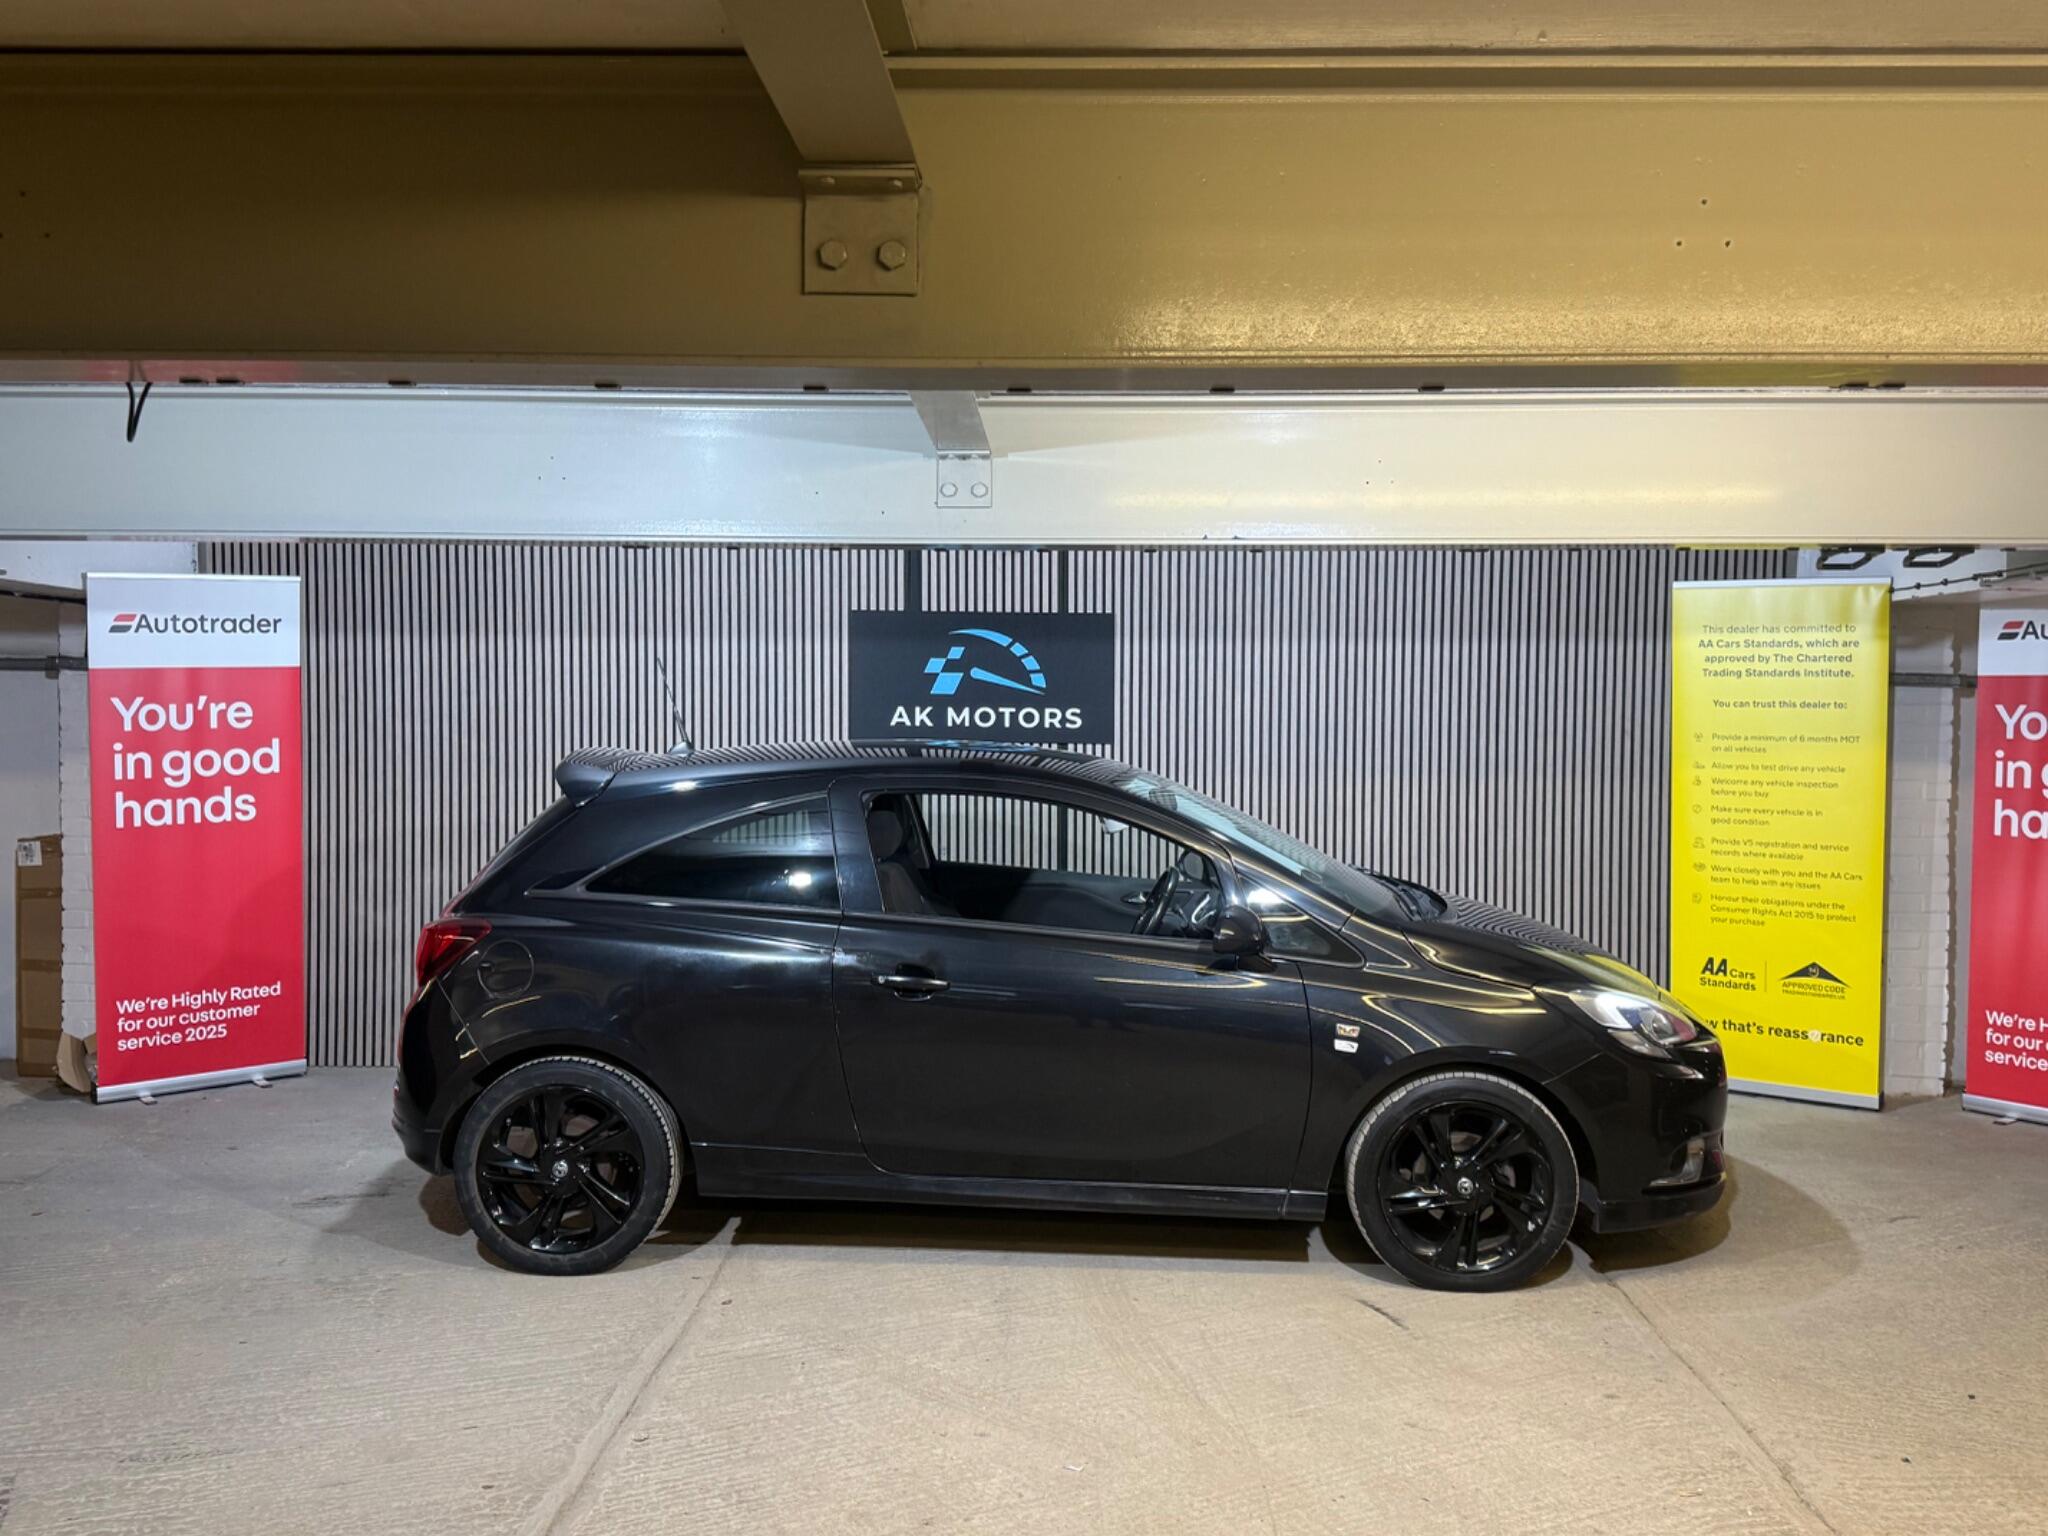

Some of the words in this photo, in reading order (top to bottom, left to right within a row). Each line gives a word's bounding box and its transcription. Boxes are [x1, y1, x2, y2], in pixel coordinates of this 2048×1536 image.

[134, 614, 282, 634] Autotrader
[1702, 625, 1724, 633] This
[1727, 625, 1759, 633] dealer
[1762, 624, 1780, 633] has
[1784, 624, 1842, 632] committed
[1845, 624, 1856, 632] to
[1698, 640, 1713, 648] AA
[1717, 640, 1740, 648] Cars
[1744, 639, 1802, 648] Standards,
[1806, 639, 1838, 648] which
[1842, 640, 1859, 648] are
[1705, 654, 1754, 663] approved
[1758, 654, 1770, 663] by
[1773, 654, 1793, 662] The
[1797, 654, 1852, 662] Chartered
[1702, 668, 1742, 678] Trading
[1745, 668, 1800, 677] Standards
[1804, 669, 1854, 678] Institute.
[1713, 700, 1730, 708] You
[1753, 700, 1776, 708] trust
[1779, 700, 1797, 708] this
[1800, 701, 1831, 709] dealer
[110, 695, 253, 732] You're
[890, 706, 933, 726] AK
[947, 707, 1082, 728] MOTORS
[1712, 733, 1742, 742] Provide
[1751, 734, 1787, 742] minimum
[1789, 734, 1797, 742] of
[1807, 735, 1838, 743] months
[1840, 735, 1861, 743] MOT
[1735, 745, 1767, 753] vehicles
[113, 742, 152, 780] in
[162, 737, 280, 788] good
[1995, 749, 2032, 789] in
[1797, 781, 1838, 789] inspection
[115, 786, 257, 829] hands
[1711, 805, 1732, 813] Make
[1753, 808, 1774, 816] every
[1777, 808, 1804, 816] vehicle
[1733, 818, 1769, 826] condition
[1803, 842, 1818, 850] and
[1821, 843, 1849, 851] service
[1711, 849, 1740, 857] records
[1743, 851, 1766, 859] where
[1763, 868, 1779, 876] with
[1782, 870, 1796, 878] you
[1799, 870, 1812, 878] and
[1844, 872, 1863, 881] Cars
[1807, 901, 1830, 909] under
[1832, 902, 1845, 910] the
[1711, 904, 1750, 914] Consumer
[1779, 910, 1792, 918] Act
[1795, 911, 1814, 919] 2015
[1827, 913, 1856, 922] protect
[1701, 957, 1727, 976] AA
[1730, 969, 1756, 979] Cars
[1700, 977, 1756, 991] Standards
[1783, 982, 1823, 992] APPROVED
[117, 997, 168, 1014] We're
[172, 989, 227, 1008] Highly
[231, 981, 281, 1000] Rated
[118, 1018, 143, 1032] for
[146, 1015, 175, 1029] our
[179, 1004, 260, 1024] customer
[1986, 1010, 2036, 1031] We're
[1722, 1019, 1763, 1035] that's
[118, 1031, 182, 1051] service
[186, 1024, 227, 1042] 2025
[1986, 1028, 2011, 1046] for
[2013, 1036, 2043, 1051] our
[1985, 1050, 2048, 1071] service
